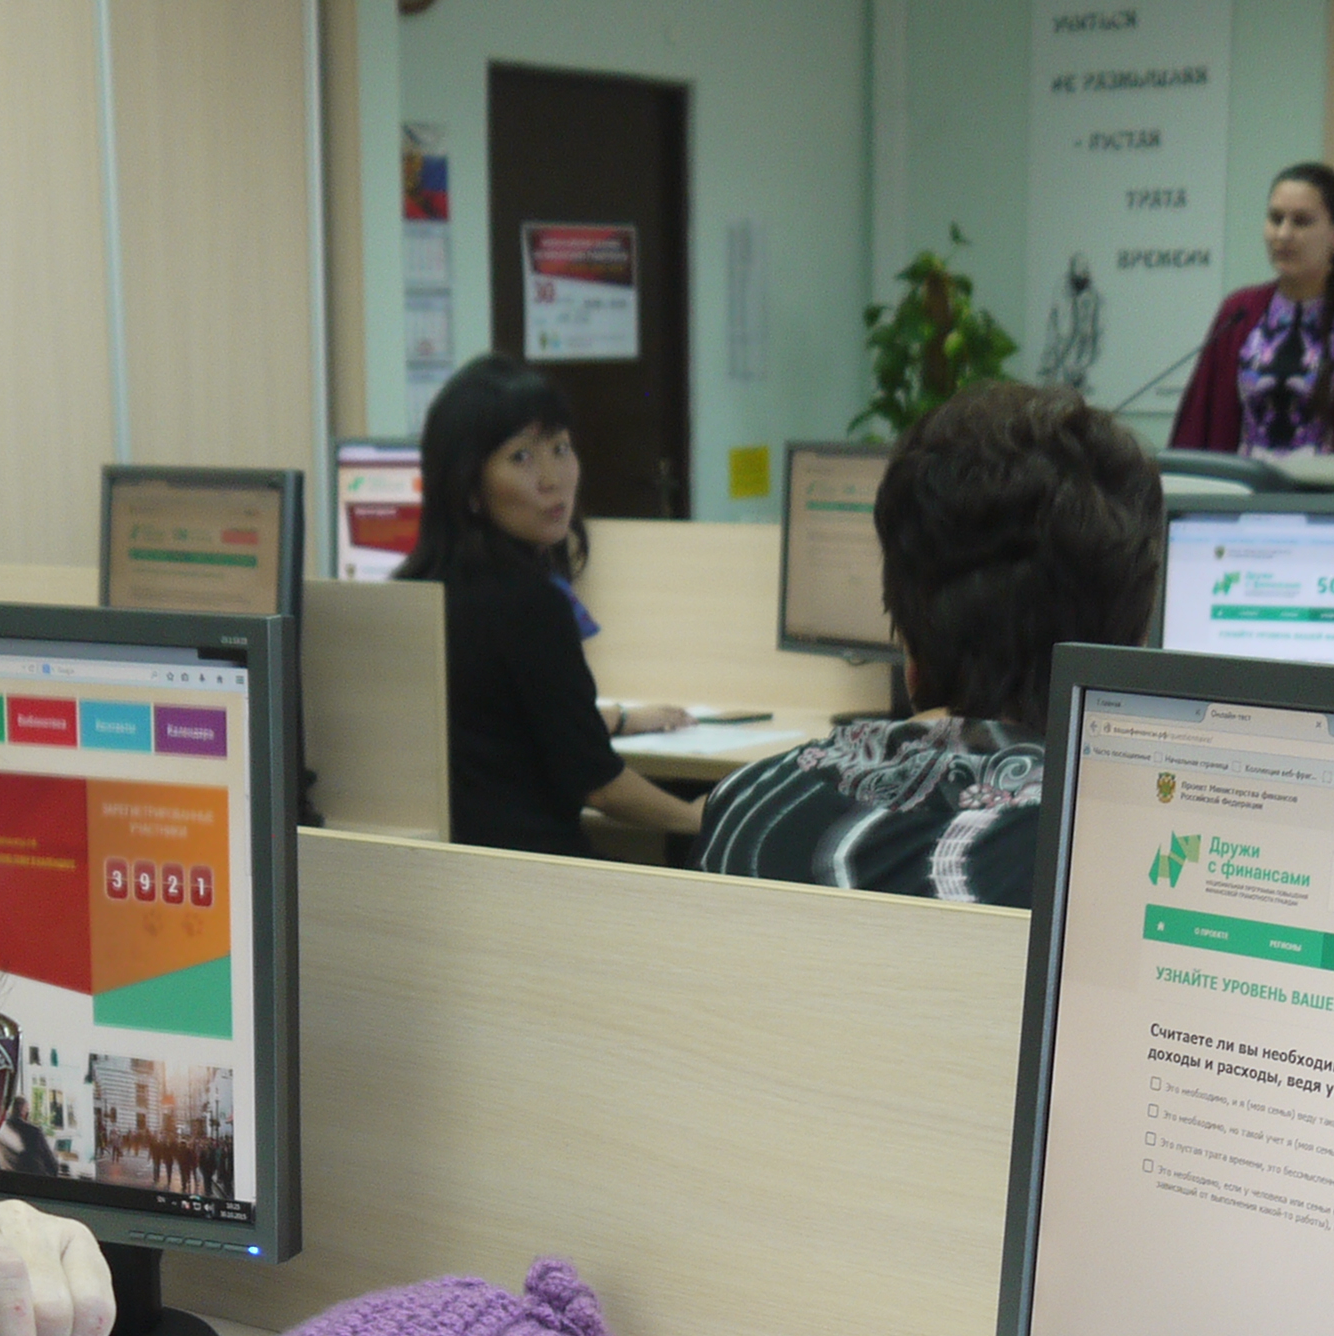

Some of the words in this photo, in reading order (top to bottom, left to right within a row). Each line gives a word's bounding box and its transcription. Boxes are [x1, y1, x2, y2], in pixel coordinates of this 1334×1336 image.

[1208, 836, 1260, 860] Дружи
[1208, 860, 1218, 874] с
[1220, 861, 1310, 888] финансами
[1155, 966, 1218, 991] УЗНАЙТЕ
[1221, 977, 1287, 1003] УРОВЕНЬ
[1150, 1022, 1213, 1048] Считаете
[1216, 1038, 1235, 1052] ли
[1238, 1043, 1258, 1057] вы
[1147, 1046, 1200, 1069] доходы
[1204, 1058, 1213, 1070] и
[1217, 1060, 1283, 1087] расходы,
[1287, 1075, 1322, 1093] ведя
[1165, 1082, 1181, 1096] Это
